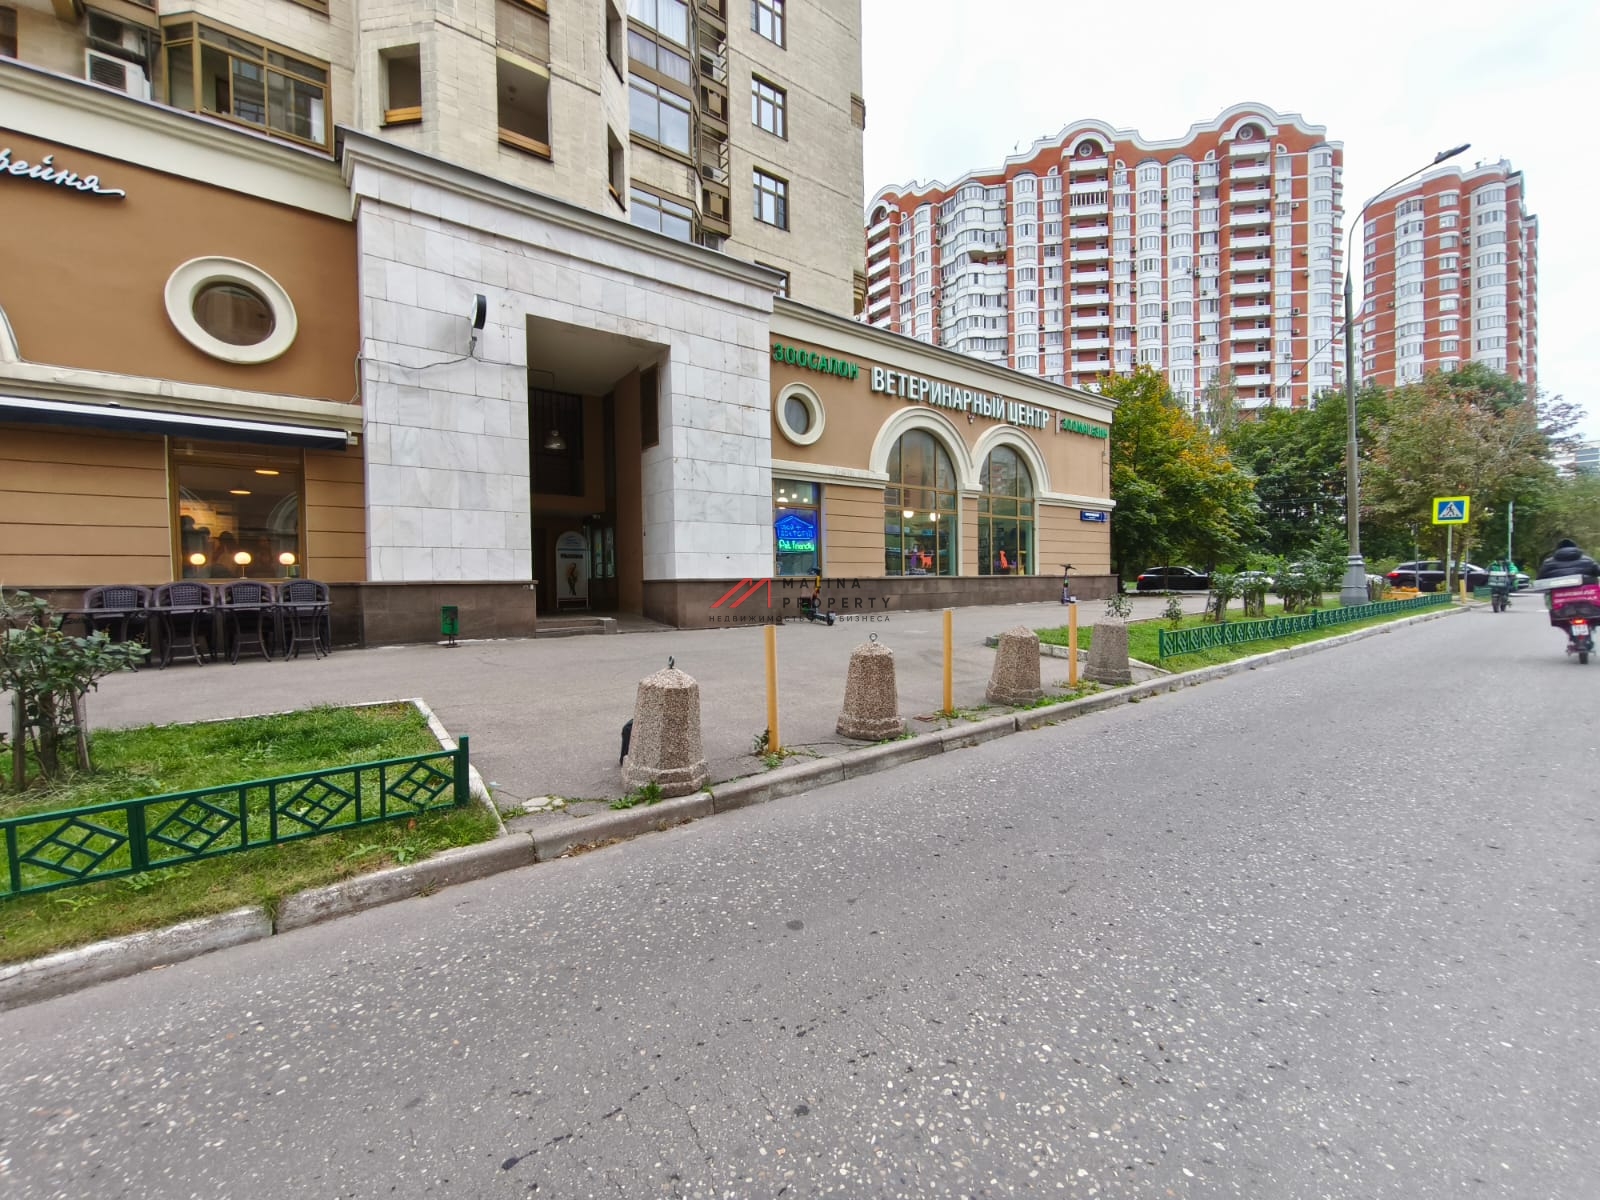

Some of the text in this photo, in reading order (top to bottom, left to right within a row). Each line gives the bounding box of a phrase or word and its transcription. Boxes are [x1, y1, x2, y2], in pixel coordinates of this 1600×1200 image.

[773, 343, 859, 380] ЗООСАЛОН
[870, 366, 1050, 430] ВЕТЕРИНАРНЫЙ ЦЕНТР
